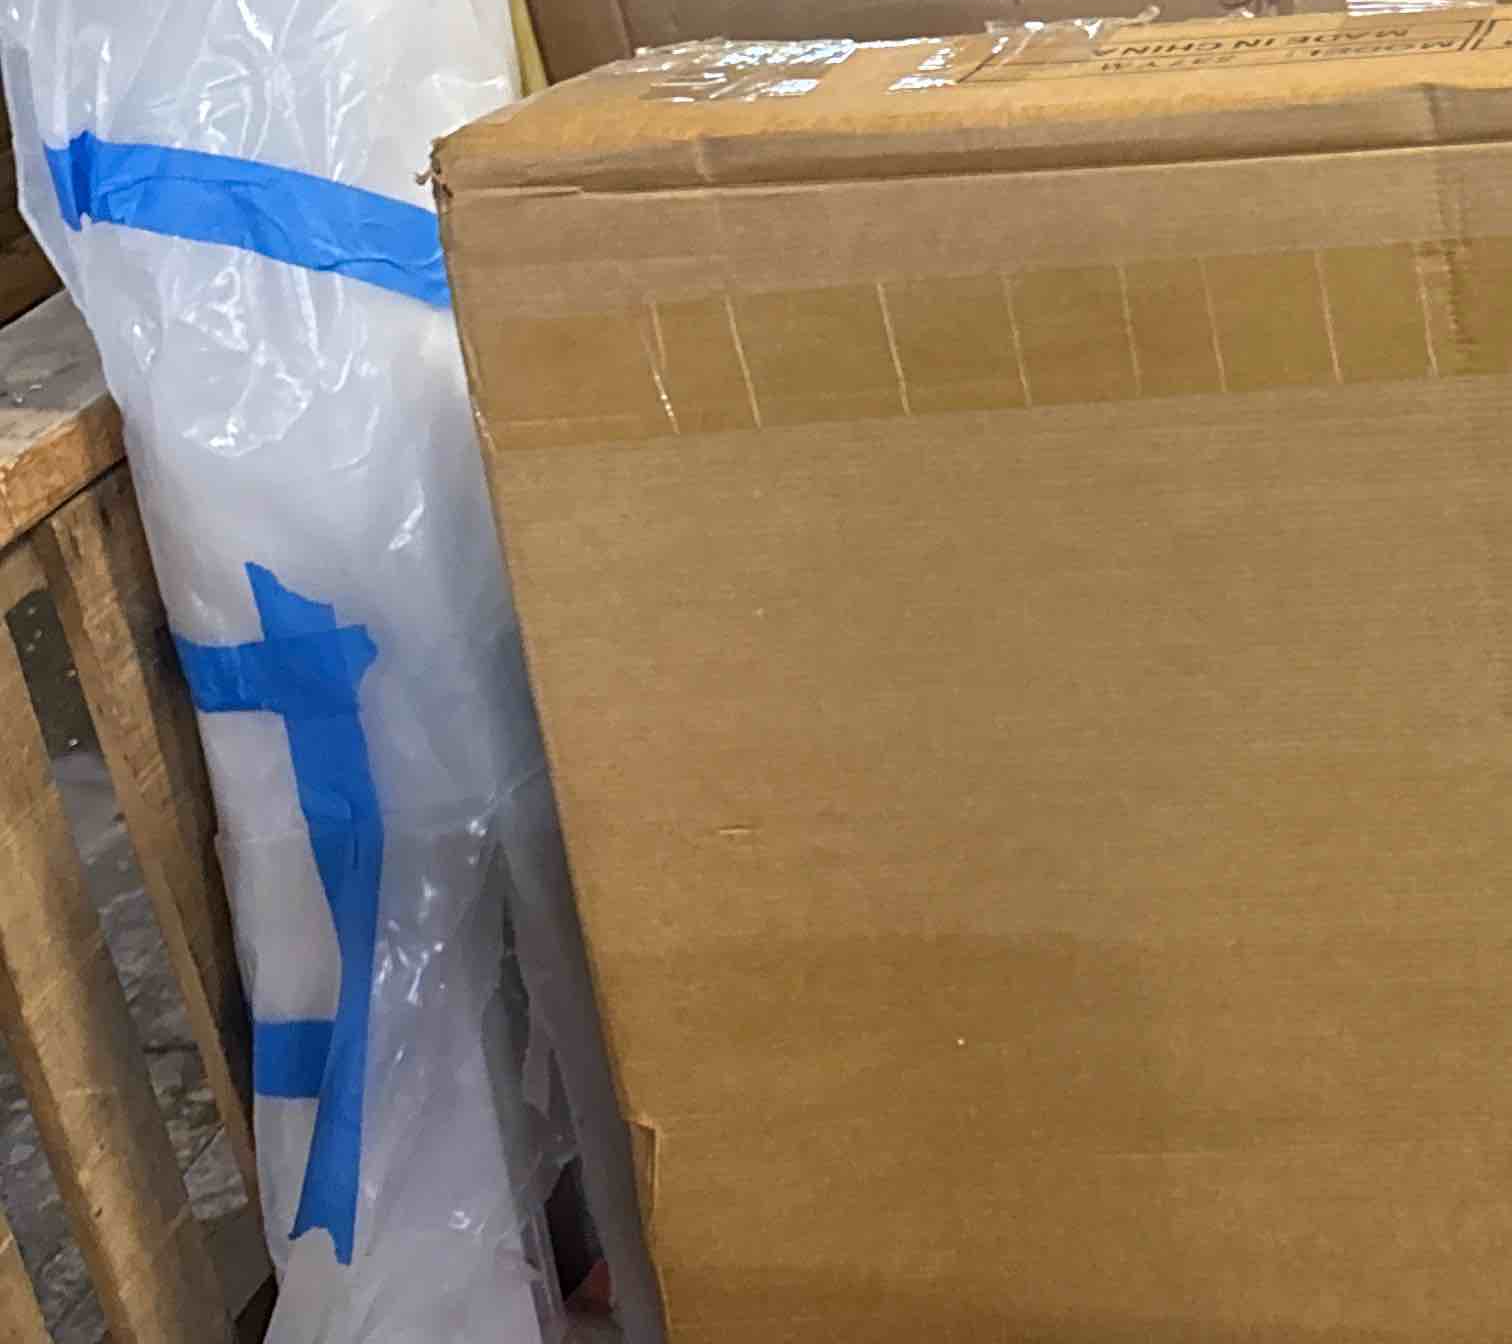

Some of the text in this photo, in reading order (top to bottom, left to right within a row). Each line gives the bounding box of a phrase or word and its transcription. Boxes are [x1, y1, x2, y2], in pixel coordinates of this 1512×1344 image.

[1091, 25, 1410, 59] MADE IN CHINA
